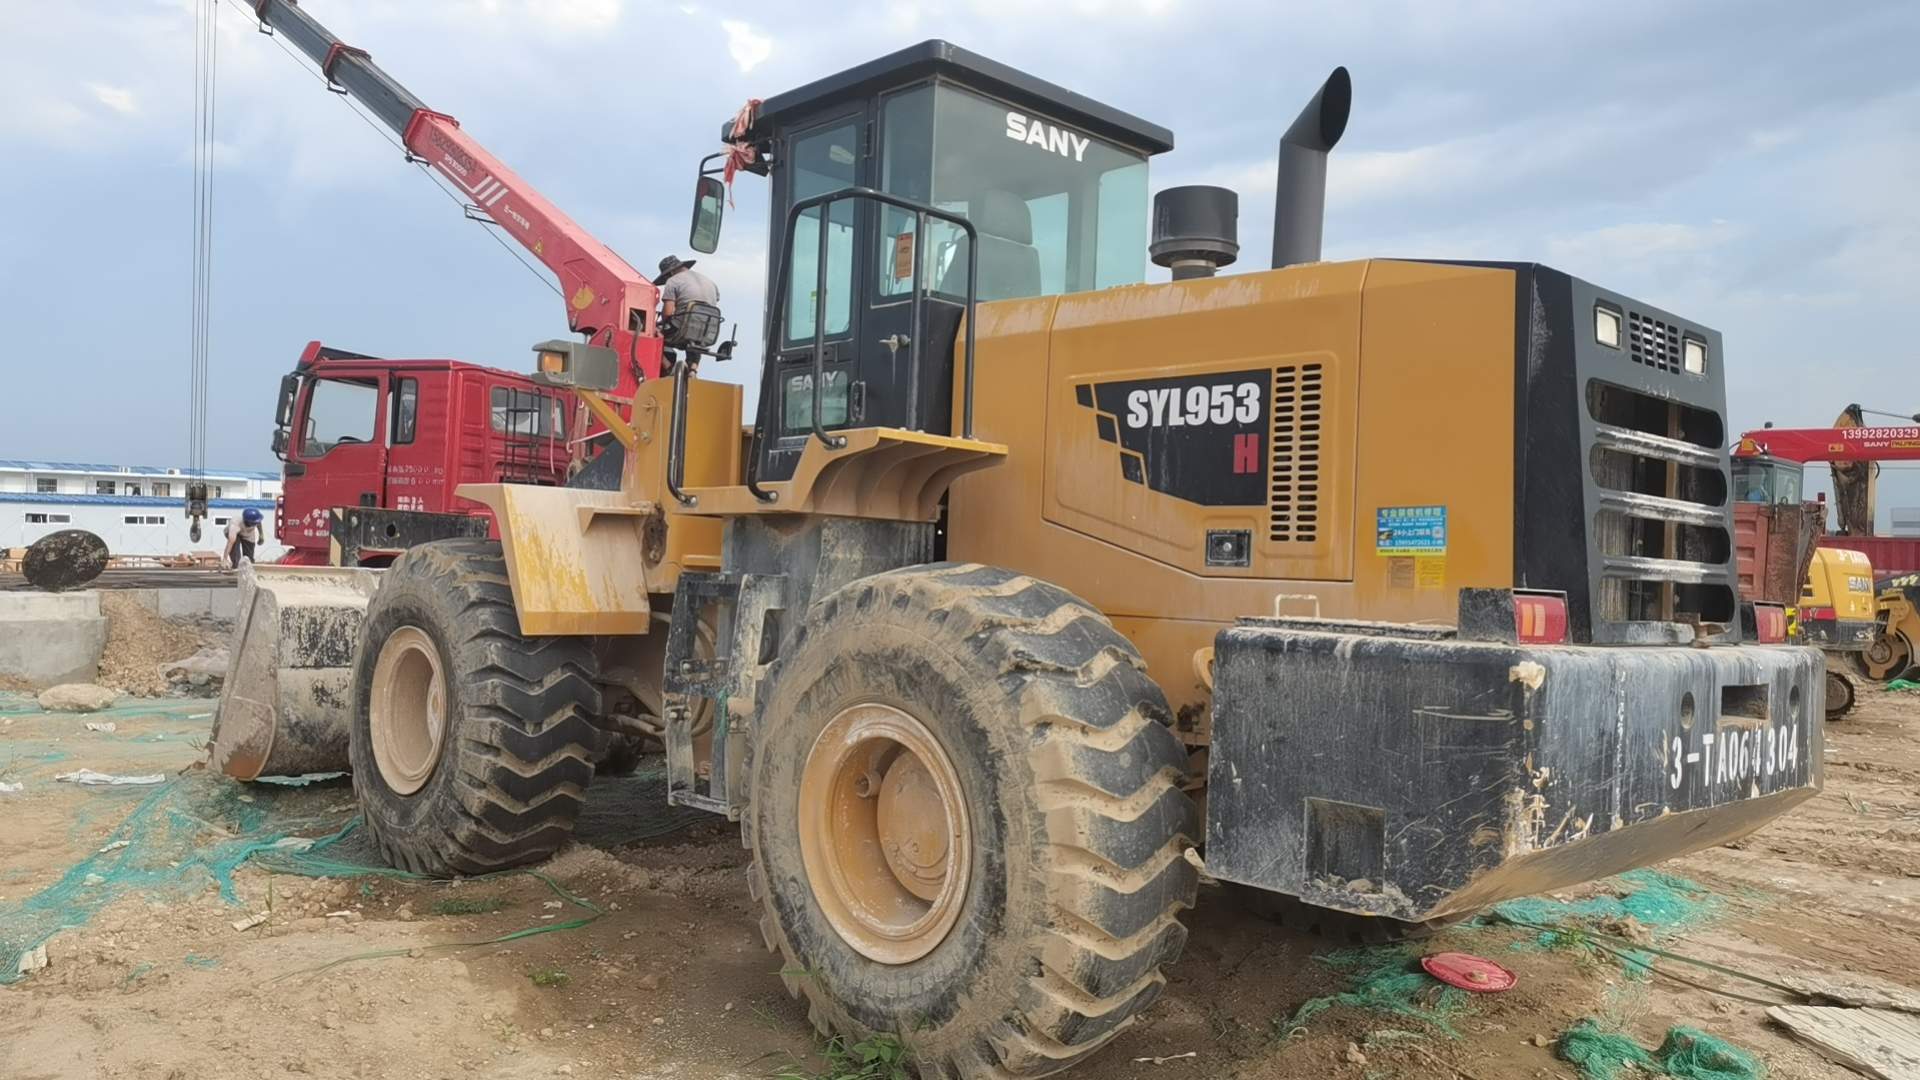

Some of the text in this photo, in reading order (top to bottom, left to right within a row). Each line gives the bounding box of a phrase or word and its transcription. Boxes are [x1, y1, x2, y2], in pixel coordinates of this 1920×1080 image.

[1006, 111, 1090, 162] SANY
[791, 370, 838, 391] SAY
[1126, 382, 1261, 429] SYL953
[1233, 433, 1259, 474] H
[1841, 428, 1919, 440] 13992820329
